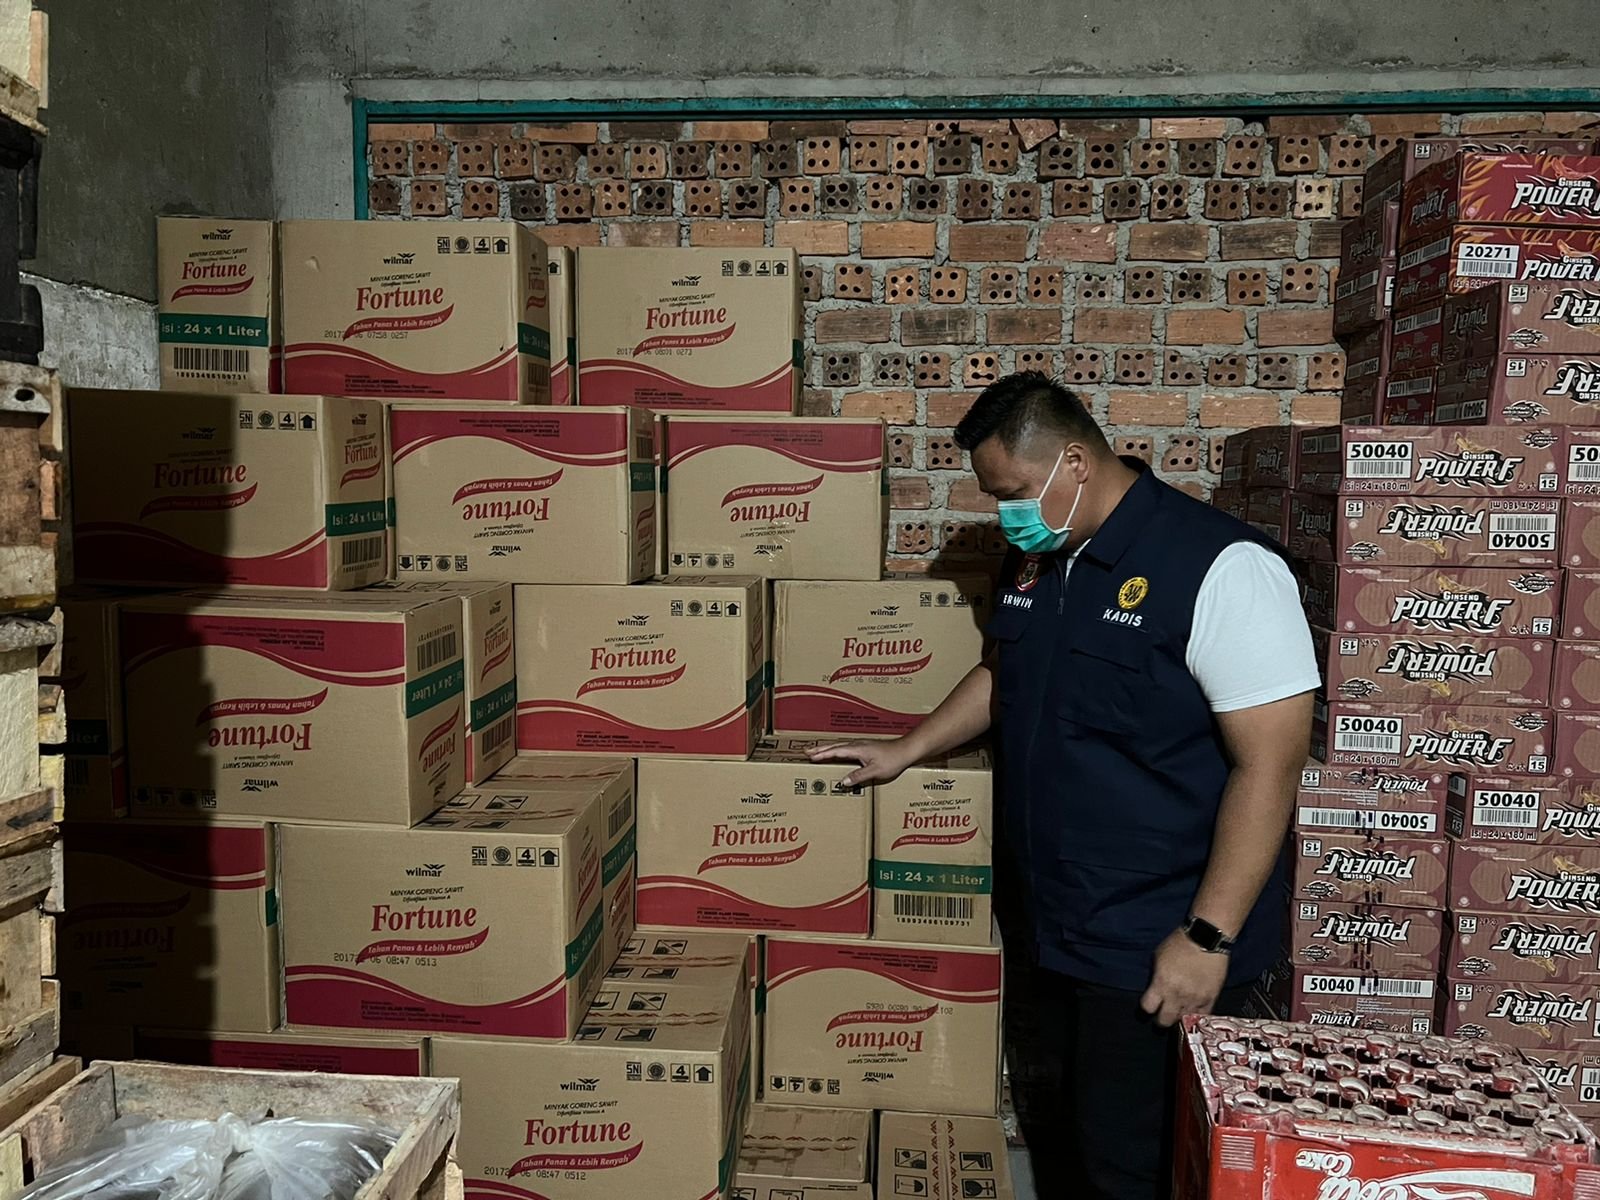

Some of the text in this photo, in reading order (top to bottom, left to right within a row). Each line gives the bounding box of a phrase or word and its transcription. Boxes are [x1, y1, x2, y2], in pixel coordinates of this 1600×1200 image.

[1417, 146, 1429, 154] 15
[202, 231, 231, 241] wilmar
[1466, 245, 1511, 258] 20271
[383, 256, 413, 266] wilmar
[182, 261, 247, 280] Fortune
[671, 279, 699, 287] wilmar
[1511, 287, 1525, 296] 15
[356, 286, 444, 312] Fortune
[645, 306, 727, 330] Fortune
[184, 323, 200, 334] 24
[204, 326, 211, 334] x
[216, 324, 223, 335] 1
[228, 325, 262, 338] Liter
[1509, 361, 1524, 371] 15
[1350, 444, 1409, 458] 50040
[153, 463, 247, 489] Fortune
[1361, 483, 1372, 491] 24
[1381, 483, 1398, 491] 180
[1541, 480, 1555, 488] 15
[462, 498, 550, 521] Fortune
[1347, 502, 1360, 511] 15
[730, 501, 811, 523] Fortune
[1492, 533, 1550, 548] 50040
[491, 545, 521, 553] wilmar
[1003, 594, 1033, 609] ERWIN
[870, 608, 898, 617] wilmar
[1102, 608, 1143, 627] KADIS
[617, 618, 647, 626] wilmar
[1535, 623, 1549, 632] 15
[842, 637, 923, 658] Fortune
[1342, 640, 1356, 649] 15
[590, 647, 676, 670] Fortune
[1339, 718, 1398, 733] 50040
[208, 723, 312, 751] Fortune
[1351, 755, 1361, 763] 24
[1371, 756, 1386, 765] 180
[1531, 761, 1545, 770] 15
[1304, 772, 1318, 781] 15
[243, 779, 279, 789] wilmar
[923, 782, 953, 791] wilmar
[740, 796, 770, 804] wilmar
[1478, 792, 1536, 807] 50040
[902, 811, 971, 830] Fortune
[1381, 813, 1429, 828] 50040
[712, 824, 799, 847] Fortune
[1306, 842, 1319, 850] 15
[405, 867, 442, 877] wilmar
[880, 870, 893, 881] Isi
[905, 872, 922, 882] 24
[926, 875, 935, 883] x
[940, 874, 946, 883] 1
[952, 874, 985, 886] Liter
[1302, 906, 1316, 914] 15
[370, 904, 477, 932] Fortune
[1461, 920, 1474, 928] 15
[386, 956, 410, 965] 08:47
[415, 957, 437, 967] 0513
[1310, 978, 1354, 990] 50040
[1457, 985, 1471, 994] 15
[1414, 1023, 1427, 1031] 15
[836, 1030, 924, 1053] Fortune
[560, 1082, 597, 1091] wilmar
[523, 1119, 631, 1146] Fortune
[544, 1159, 568, 1167] Panas
[577, 1157, 599, 1166] Lebih
[1296, 1150, 1352, 1177] Coke
[536, 1170, 560, 1179] 08:47
[564, 1171, 586, 1180] 0512
